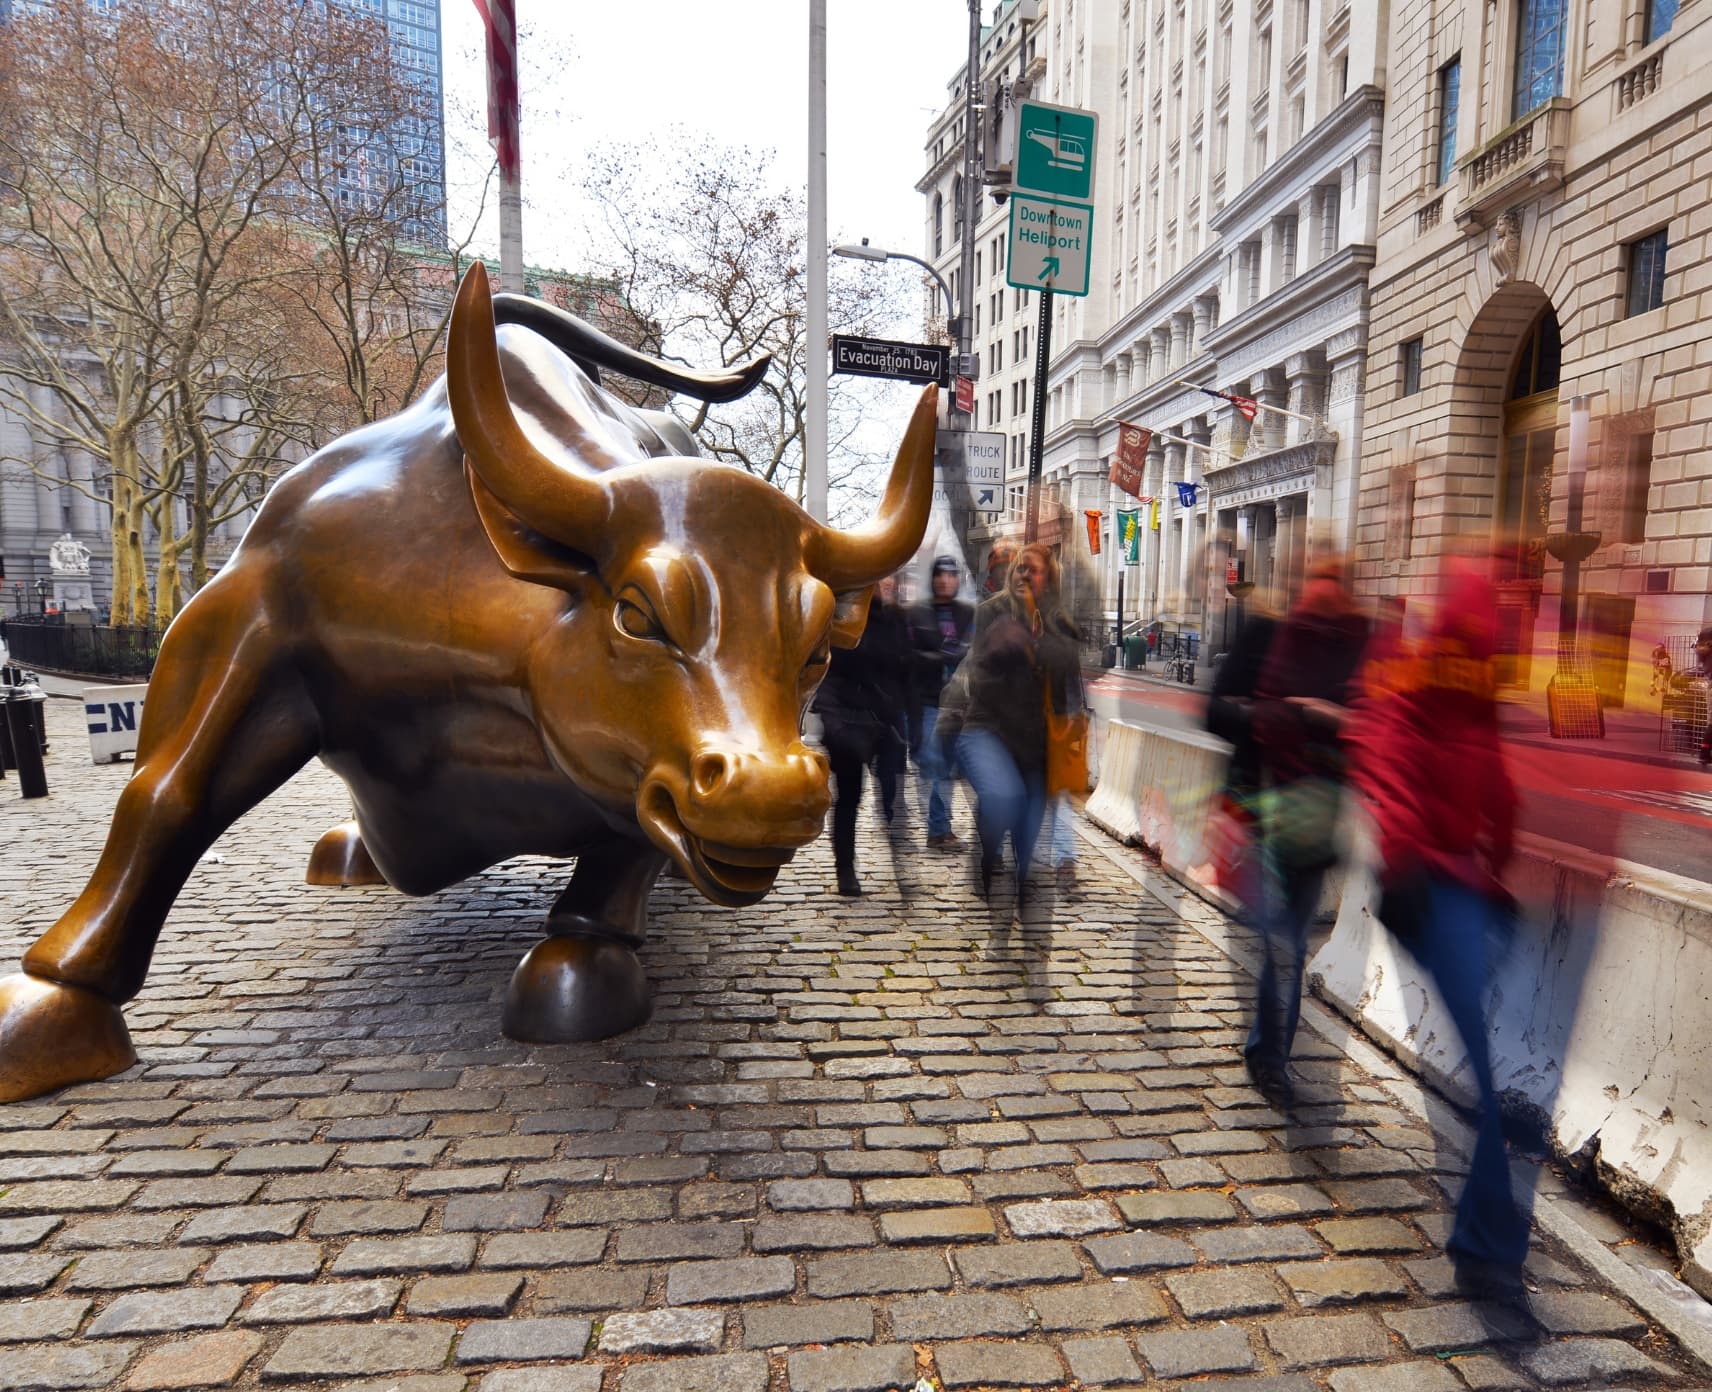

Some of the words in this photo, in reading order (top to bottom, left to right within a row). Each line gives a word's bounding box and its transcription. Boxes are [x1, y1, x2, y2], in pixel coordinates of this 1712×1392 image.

[1020, 206, 1082, 230] Downtown
[1019, 227, 1080, 250] Heliport
[862, 343, 889, 353] November
[840, 347, 911, 370] Evacuation
[914, 356, 938, 375] Day
[968, 445, 1000, 459] TRUCK
[967, 466, 1000, 479] ROUTE
[1124, 515, 1137, 561] SUBWAY
